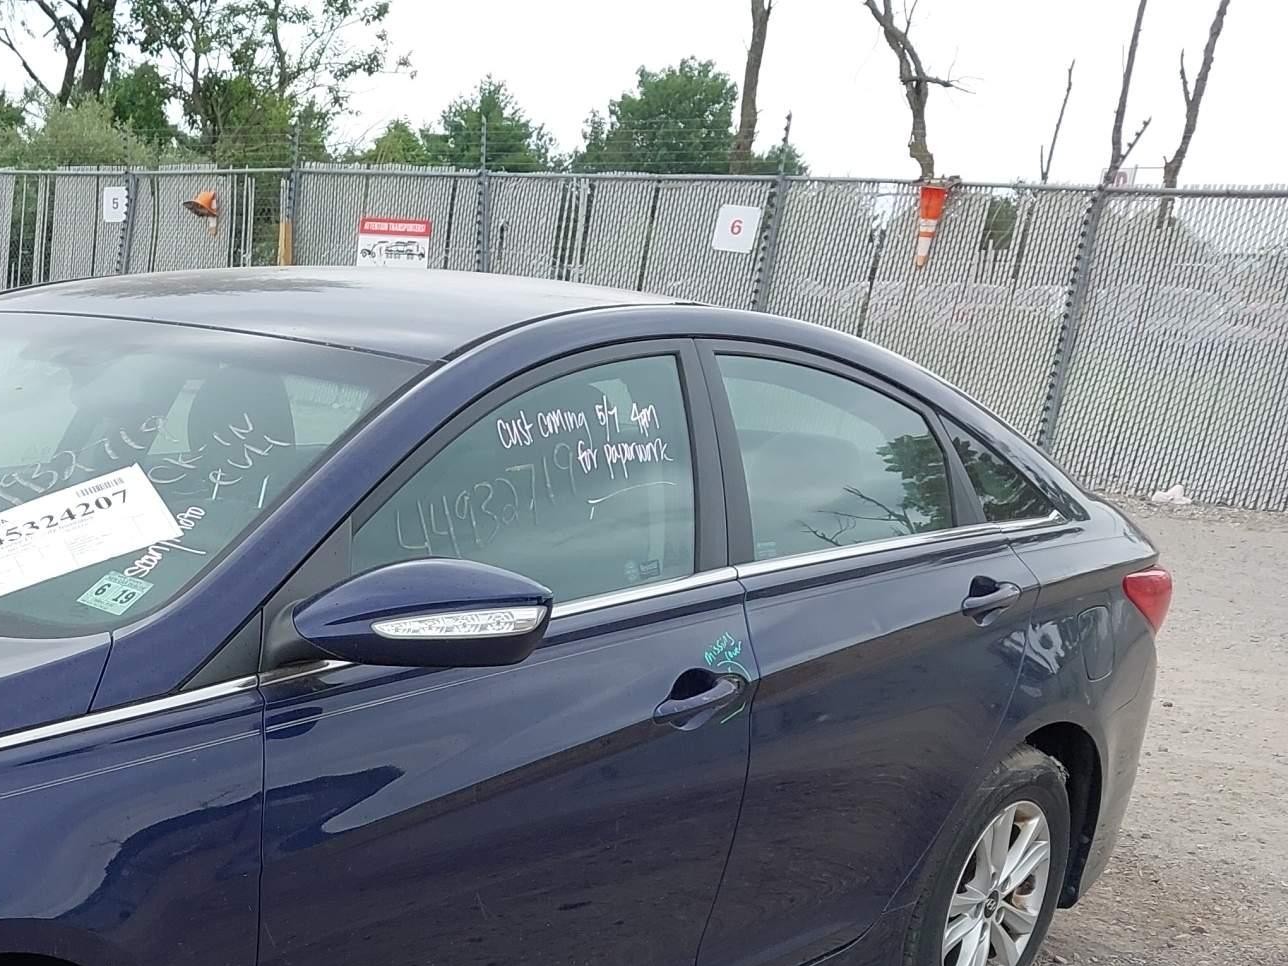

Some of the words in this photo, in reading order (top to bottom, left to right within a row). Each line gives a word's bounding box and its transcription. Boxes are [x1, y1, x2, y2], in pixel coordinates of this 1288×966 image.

[112, 197, 119, 210] 5
[730, 219, 743, 236] 6
[577, 440, 598, 474] for
[603, 438, 674, 480] paperwork
[396, 442, 578, 560] 44932719
[94, 583, 112, 596] 6
[112, 589, 137, 605] 19
